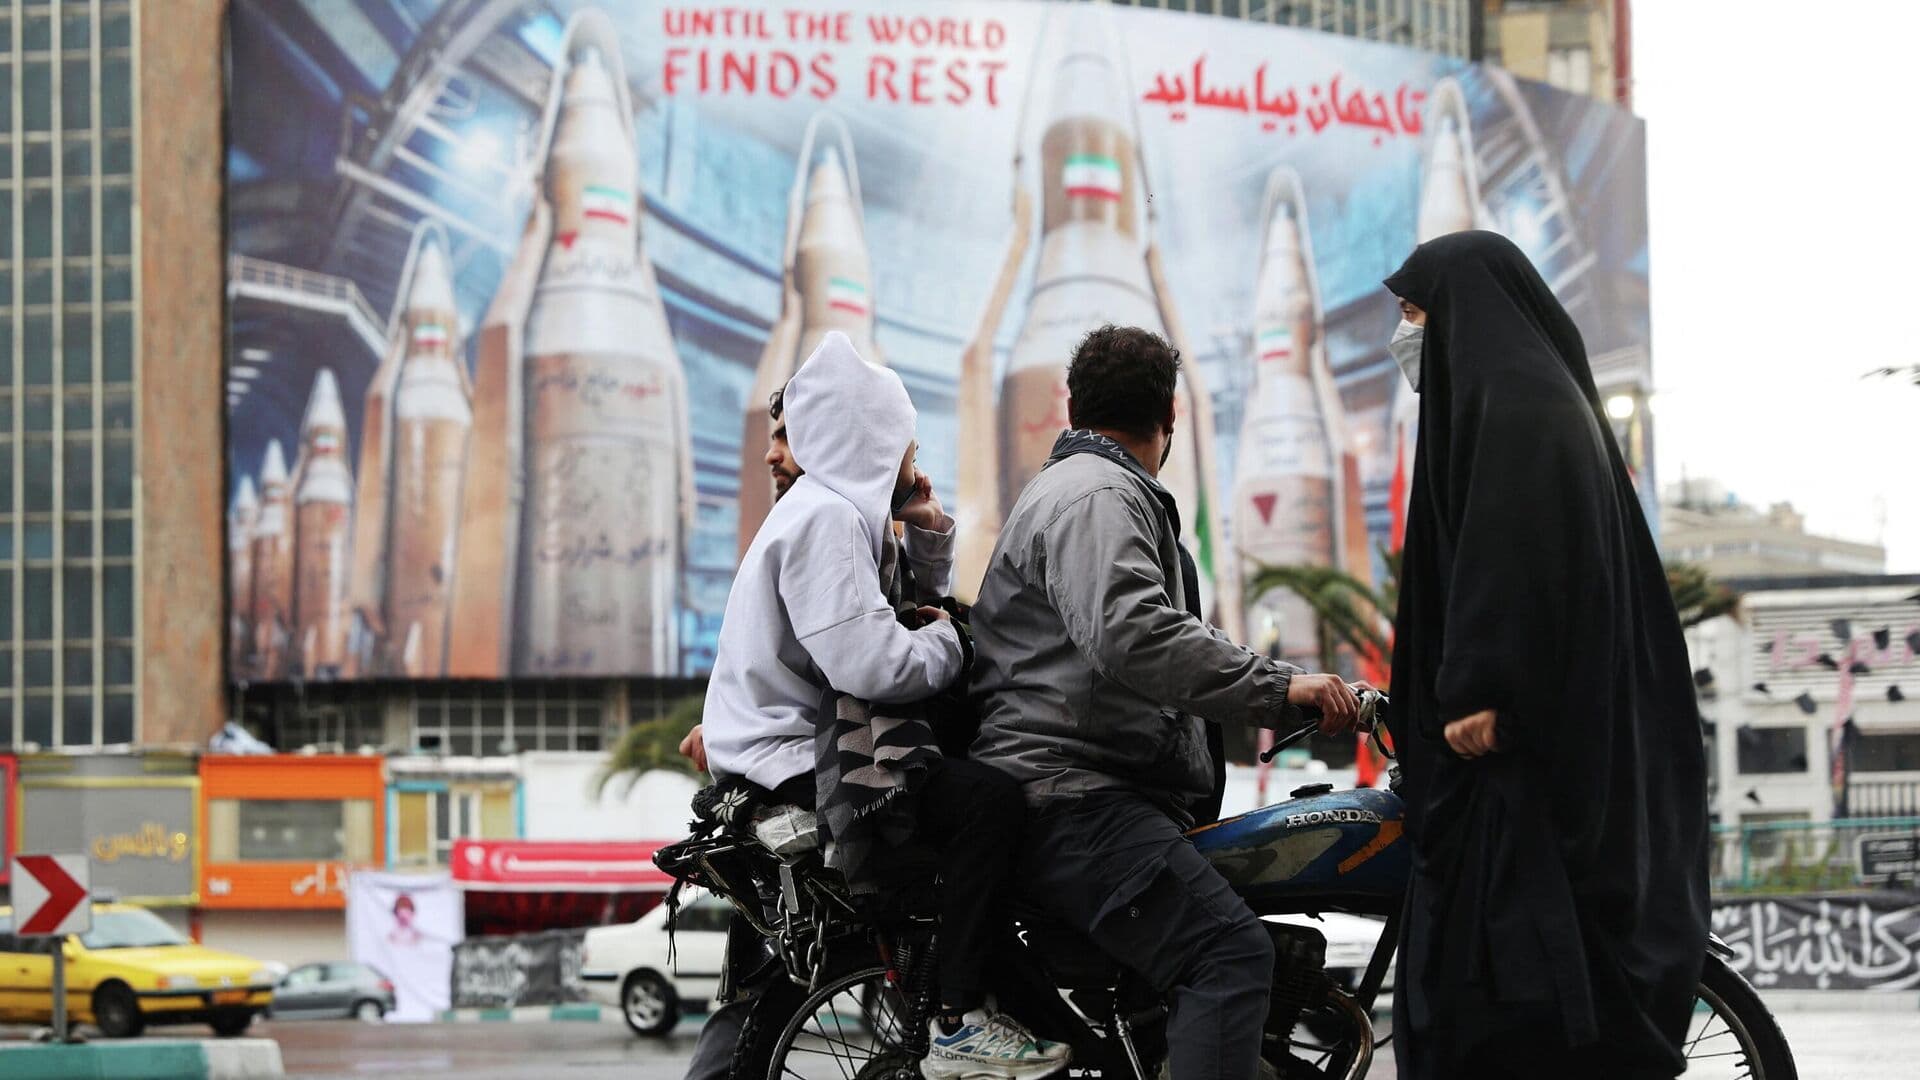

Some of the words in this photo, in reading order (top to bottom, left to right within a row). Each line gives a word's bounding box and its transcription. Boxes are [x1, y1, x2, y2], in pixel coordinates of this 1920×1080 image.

[663, 8, 771, 40] UNTIL
[783, 11, 852, 43] THE
[867, 16, 1006, 49] WORLD
[662, 49, 838, 100] FINDS
[868, 55, 1007, 107] REST
[1305, 71, 1397, 147] جهان
[1396, 82, 1427, 136] تا
[1286, 809, 1383, 829] HONDA
